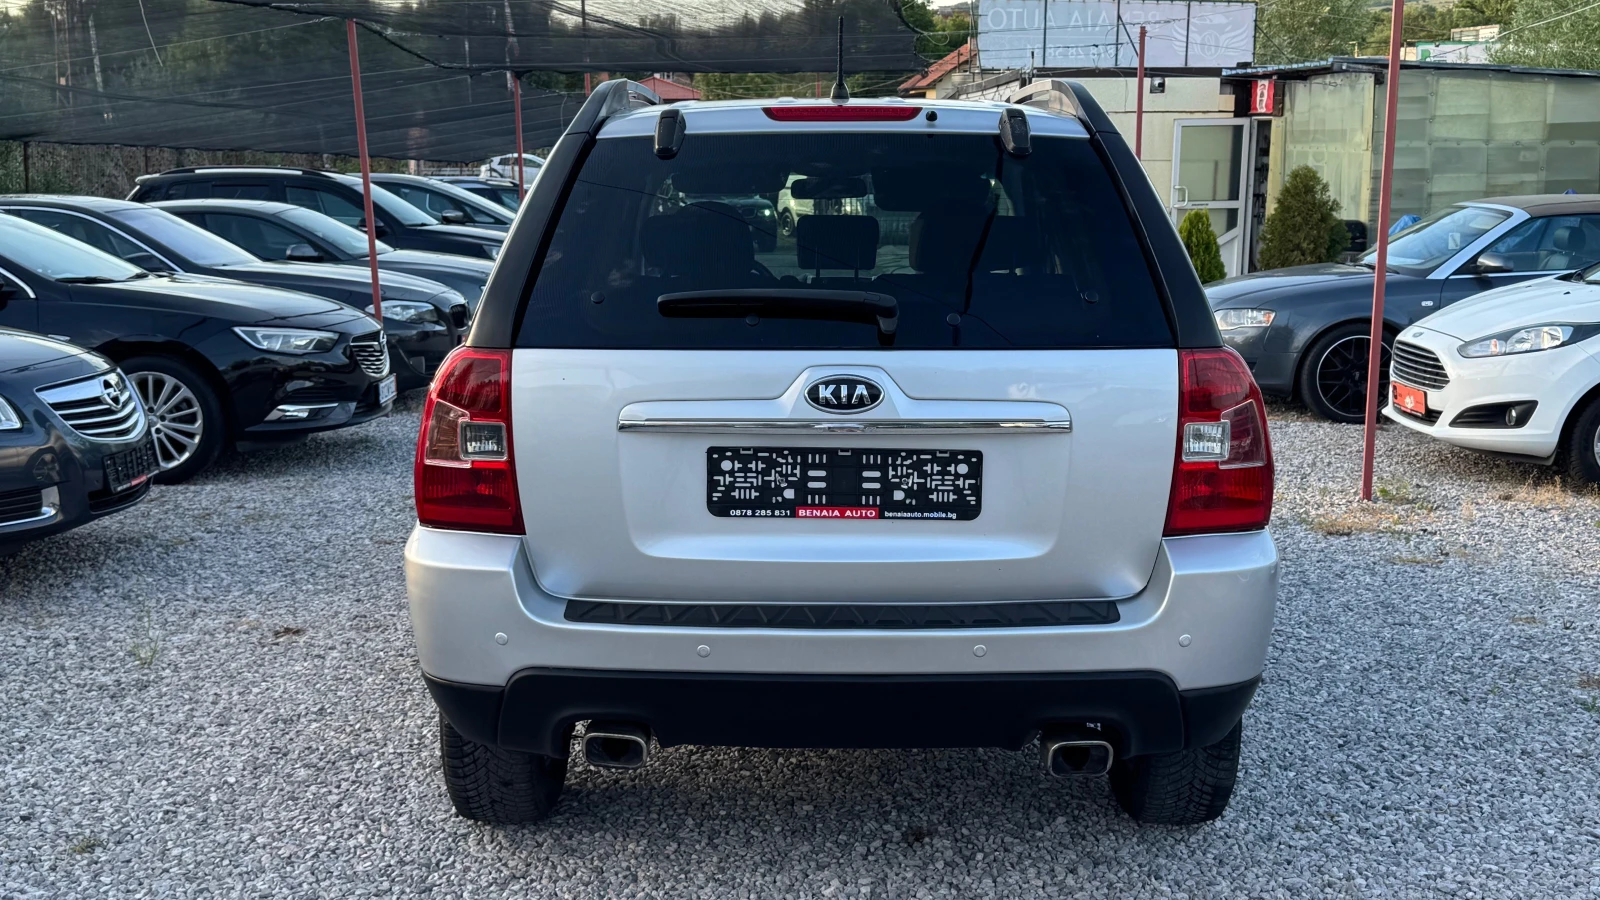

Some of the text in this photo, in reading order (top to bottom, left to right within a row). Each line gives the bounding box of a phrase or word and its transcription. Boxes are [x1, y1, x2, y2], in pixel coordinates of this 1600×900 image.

[818, 384, 872, 405] KIA
[798, 509, 841, 517] BENAIA
[844, 509, 876, 517] AUTO
[884, 510, 957, 520] benaiaauto.mobile.bg
